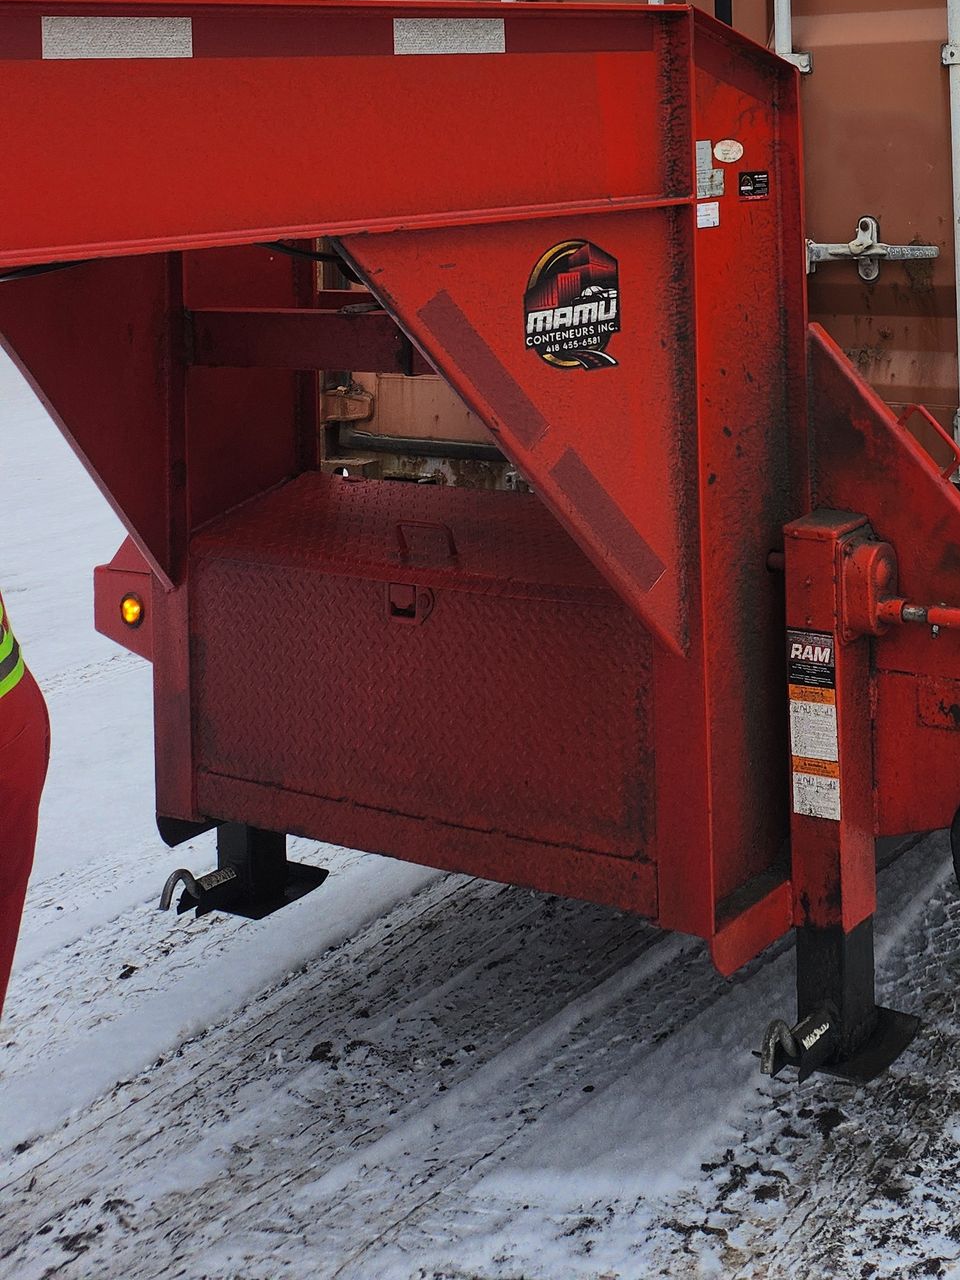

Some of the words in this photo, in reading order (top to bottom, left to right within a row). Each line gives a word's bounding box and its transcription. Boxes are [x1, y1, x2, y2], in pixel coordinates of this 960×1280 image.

[526, 298, 618, 334] MAMU
[526, 325, 595, 346] CONTENEURS
[597, 321, 619, 333] INC.
[545, 343, 560, 353] 418
[562, 335, 601, 350] 455-6581
[790, 643, 831, 664] RAM
